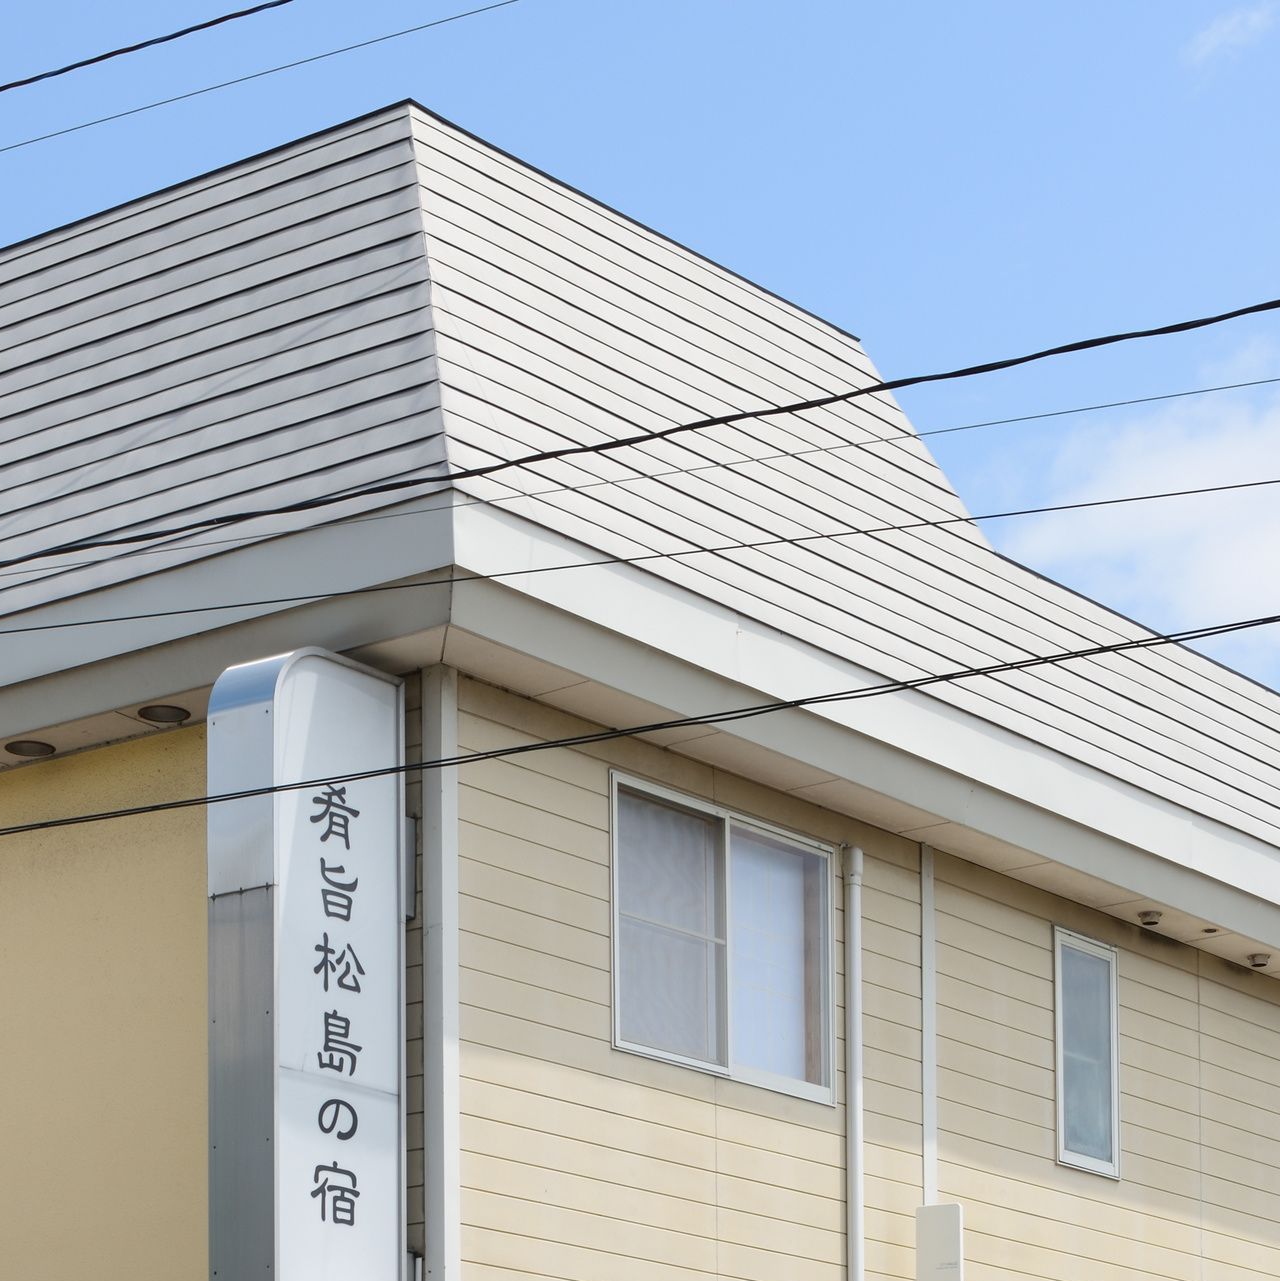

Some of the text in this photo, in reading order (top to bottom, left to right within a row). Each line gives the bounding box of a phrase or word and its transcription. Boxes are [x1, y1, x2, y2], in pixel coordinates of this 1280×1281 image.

[309, 783, 363, 1227] 肴旨松島の宿
